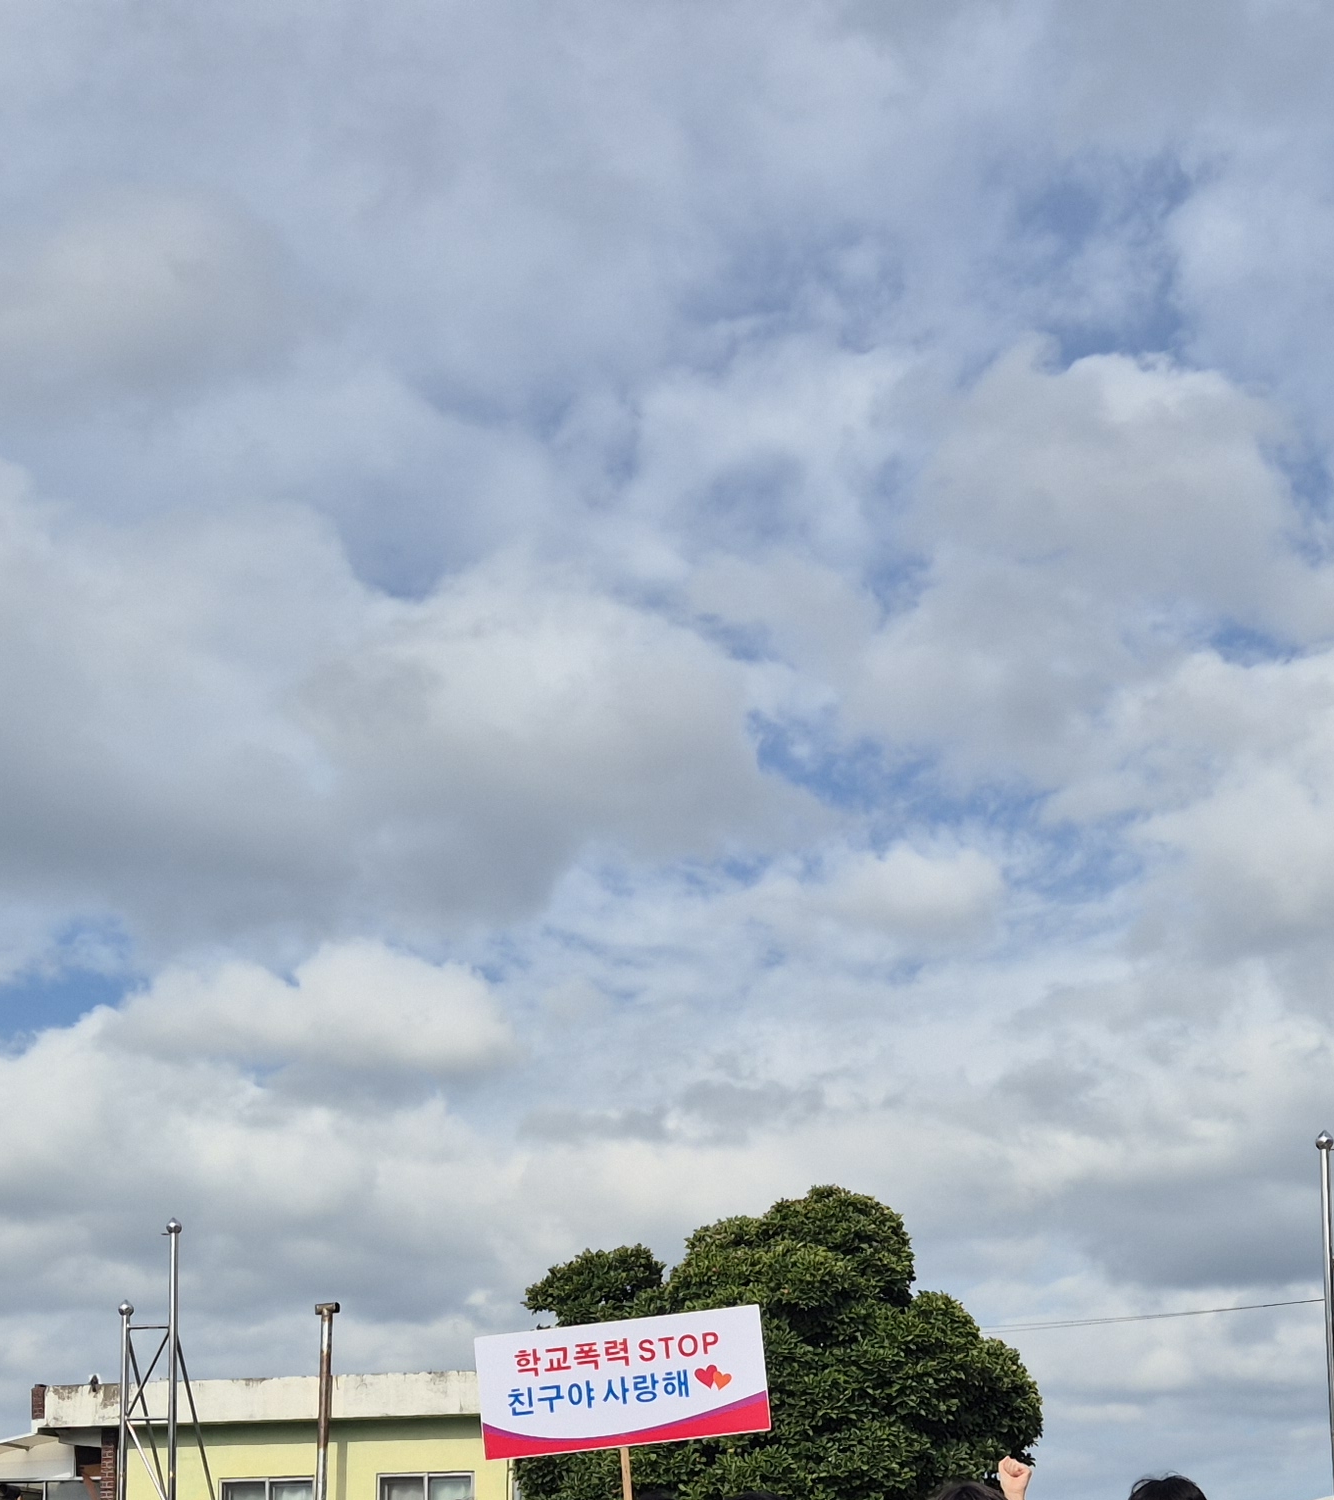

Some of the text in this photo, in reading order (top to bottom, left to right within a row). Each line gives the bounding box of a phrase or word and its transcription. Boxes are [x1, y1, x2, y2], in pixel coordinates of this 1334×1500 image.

[514, 1331, 719, 1377] 학교폭력 STOP
[508, 1369, 690, 1416] 친구야 사랑해
